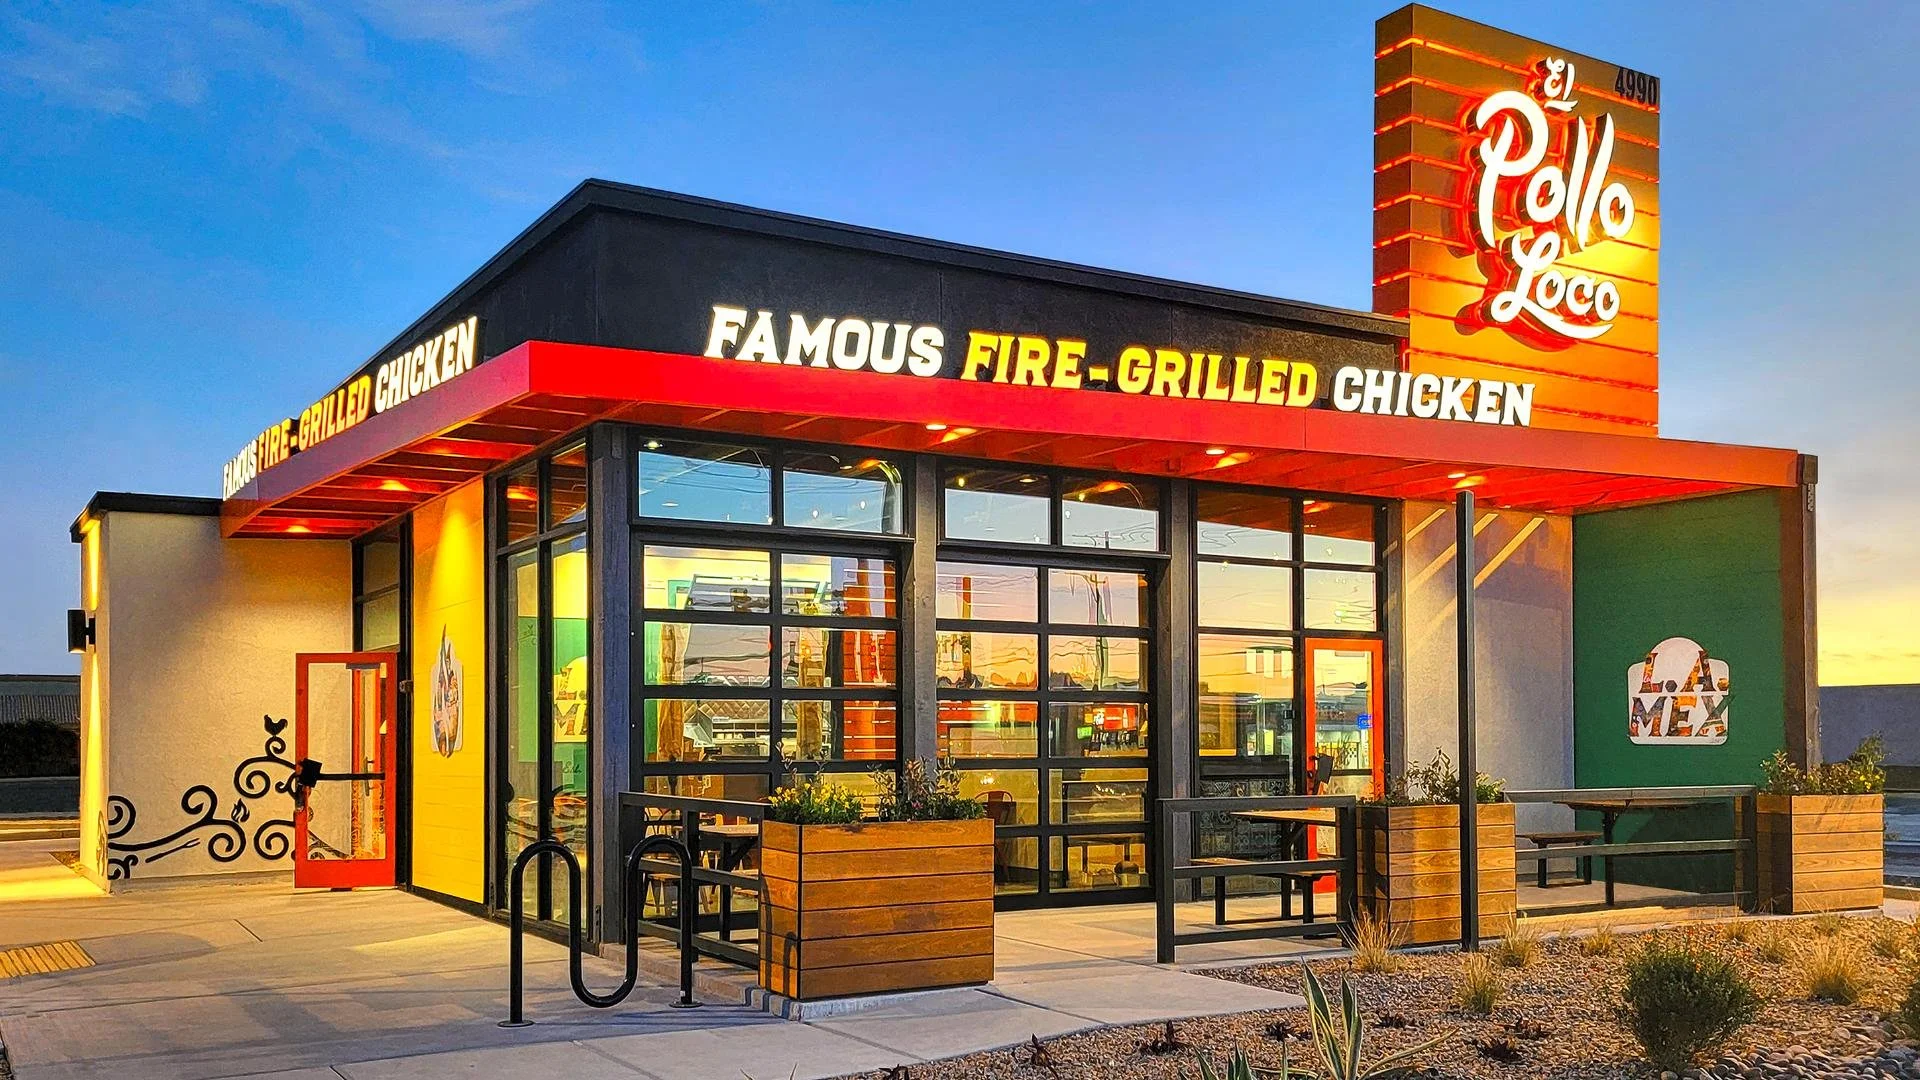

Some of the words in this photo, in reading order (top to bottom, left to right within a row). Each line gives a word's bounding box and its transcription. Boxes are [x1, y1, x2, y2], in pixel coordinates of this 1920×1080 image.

[1614, 66, 1657, 105] 4990
[1475, 90, 1635, 249] Pollo
[1490, 230, 1620, 339] Loco
[222, 439, 257, 501] FAMOUS
[258, 375, 371, 473] FIRE-GRILLED
[374, 315, 478, 413] CHICKEN
[704, 306, 945, 377] FAMOUS
[960, 331, 1318, 408] FIRE-GRILLED
[1333, 366, 1535, 427] CHICKEN
[1630, 695, 1736, 737] MEX
[1638, 650, 1729, 693] L.A.
